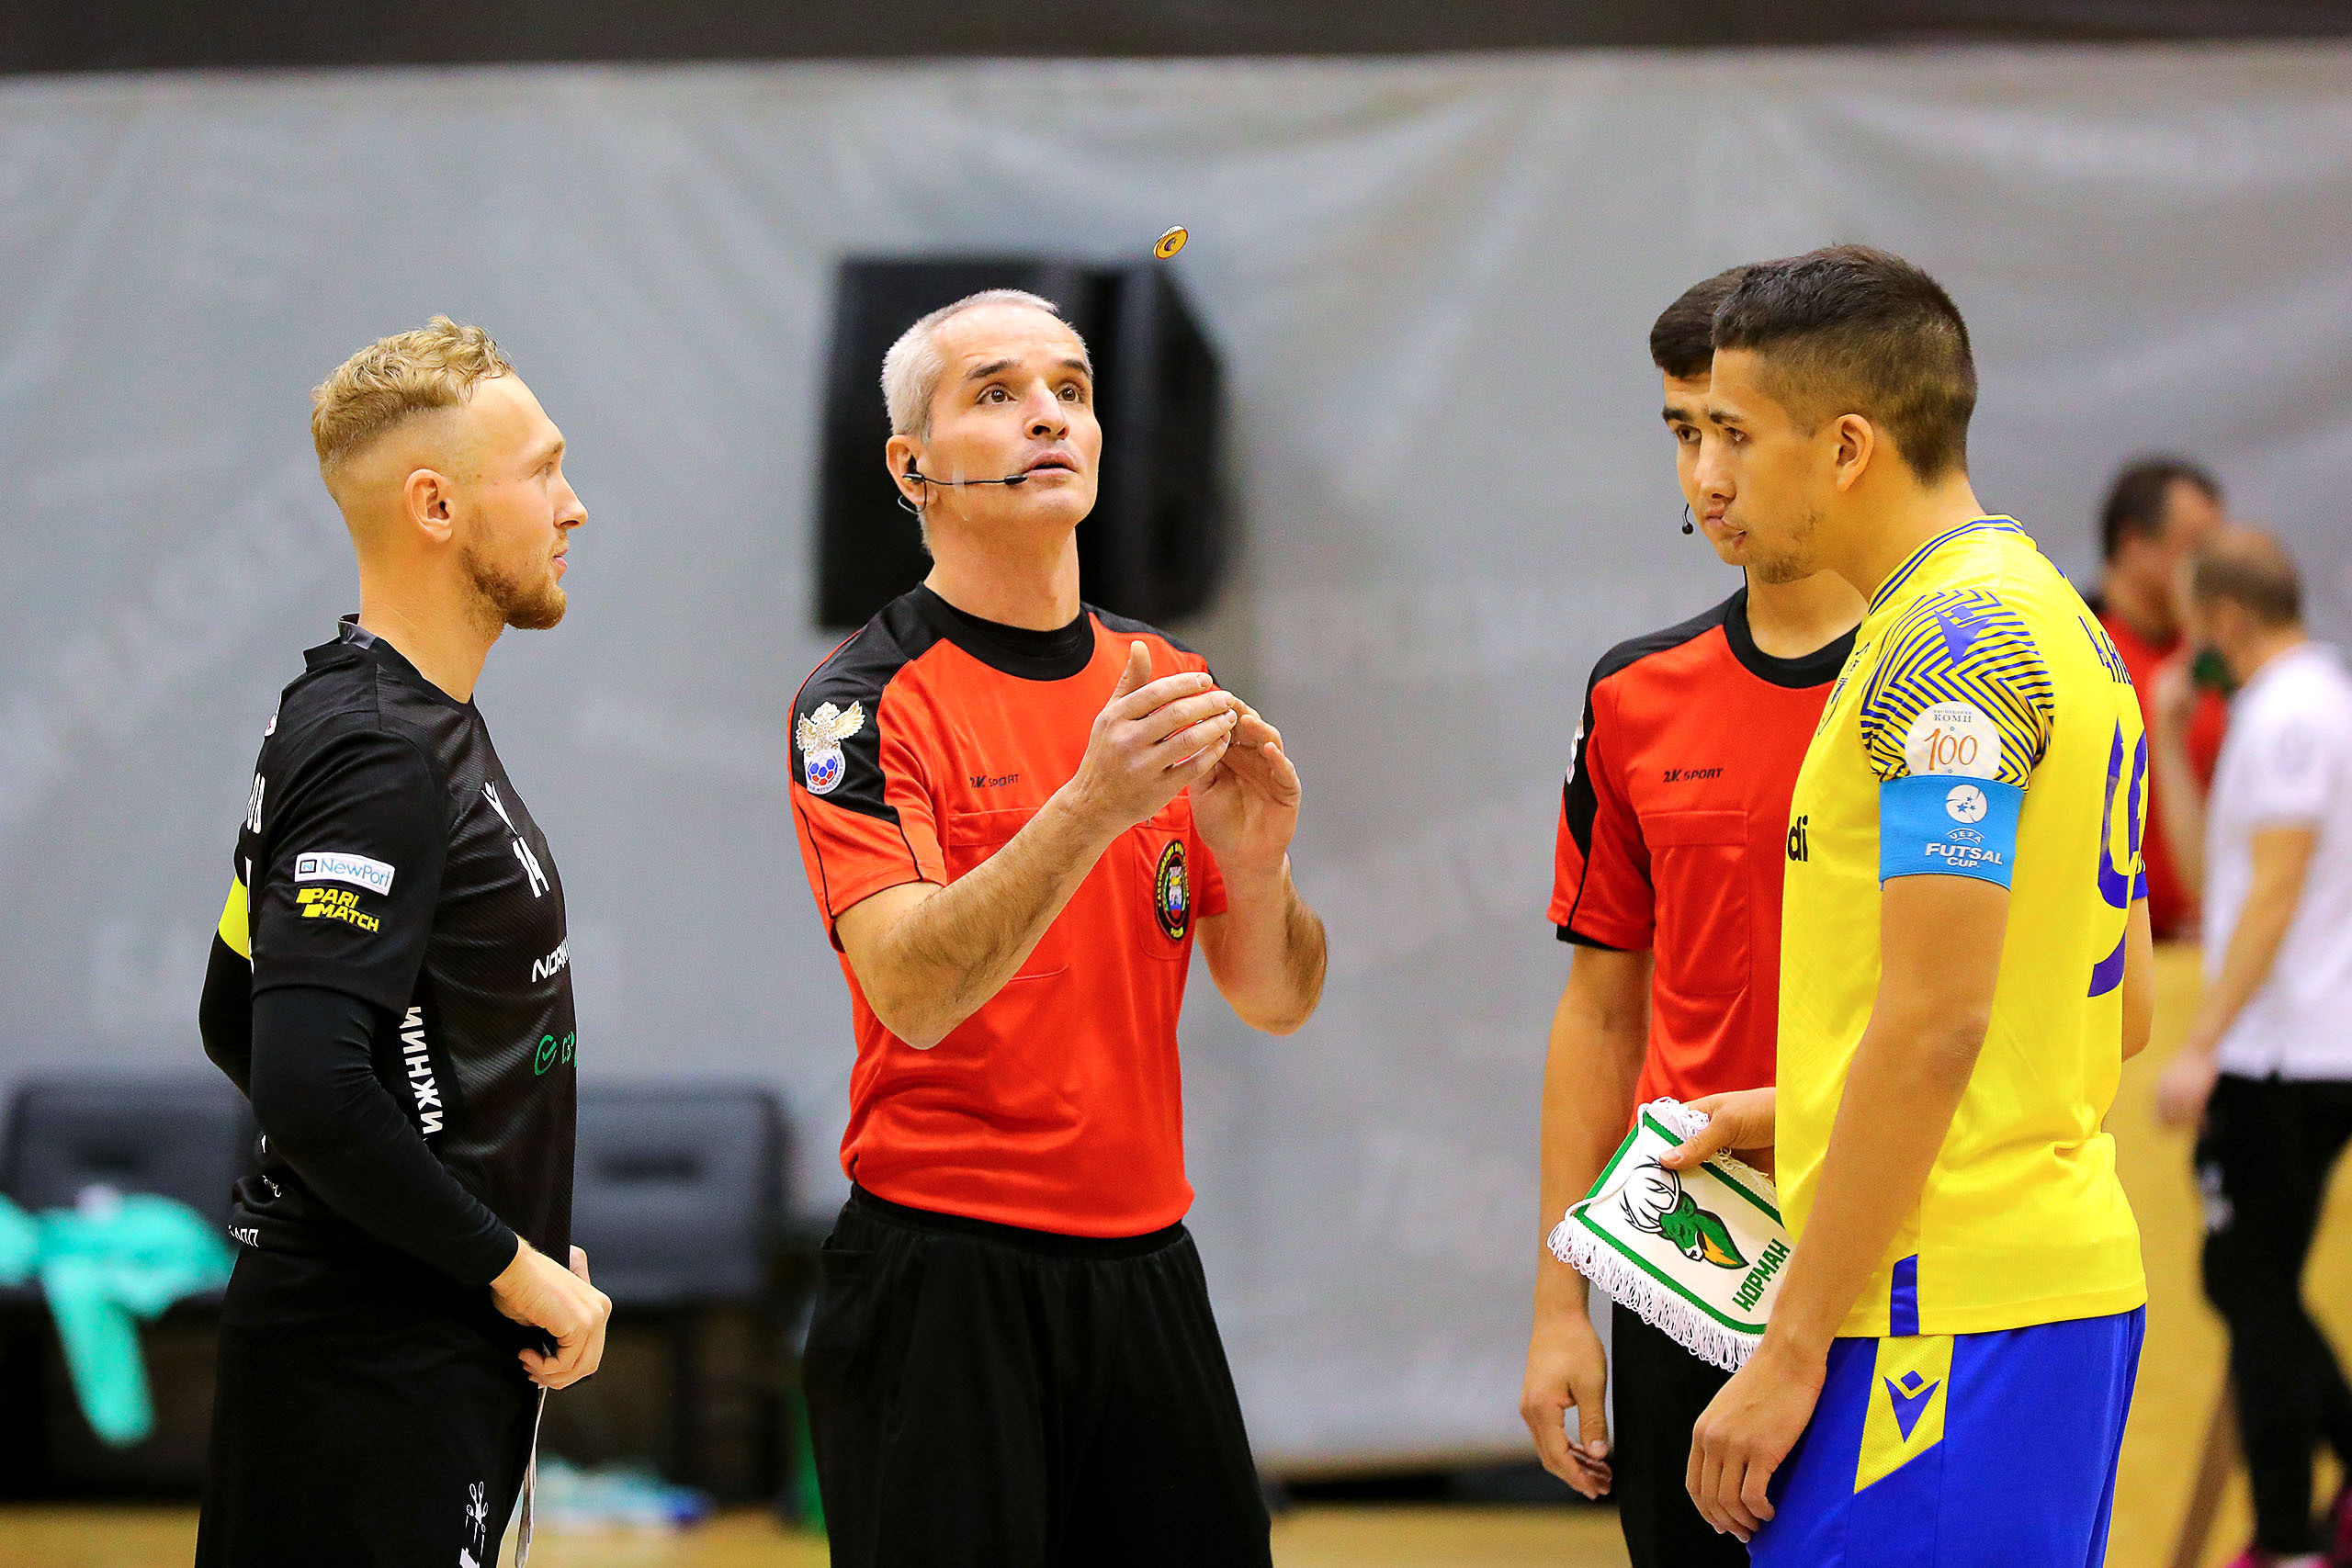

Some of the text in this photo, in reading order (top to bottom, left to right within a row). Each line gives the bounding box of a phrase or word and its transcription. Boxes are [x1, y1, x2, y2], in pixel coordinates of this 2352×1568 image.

[1934, 714, 1972, 723] КОМИ
[1924, 728, 1977, 771] 100
[989, 773, 1019, 787] SPORT
[1684, 768, 1724, 781] SPORT
[1949, 830, 1983, 843] UEFA
[1925, 842, 2003, 865] FUTSAL
[321, 858, 391, 887] NewPort
[296, 887, 359, 908] PARI
[301, 903, 379, 932] MATCH
[1732, 1237, 1791, 1313] НОРМАН
